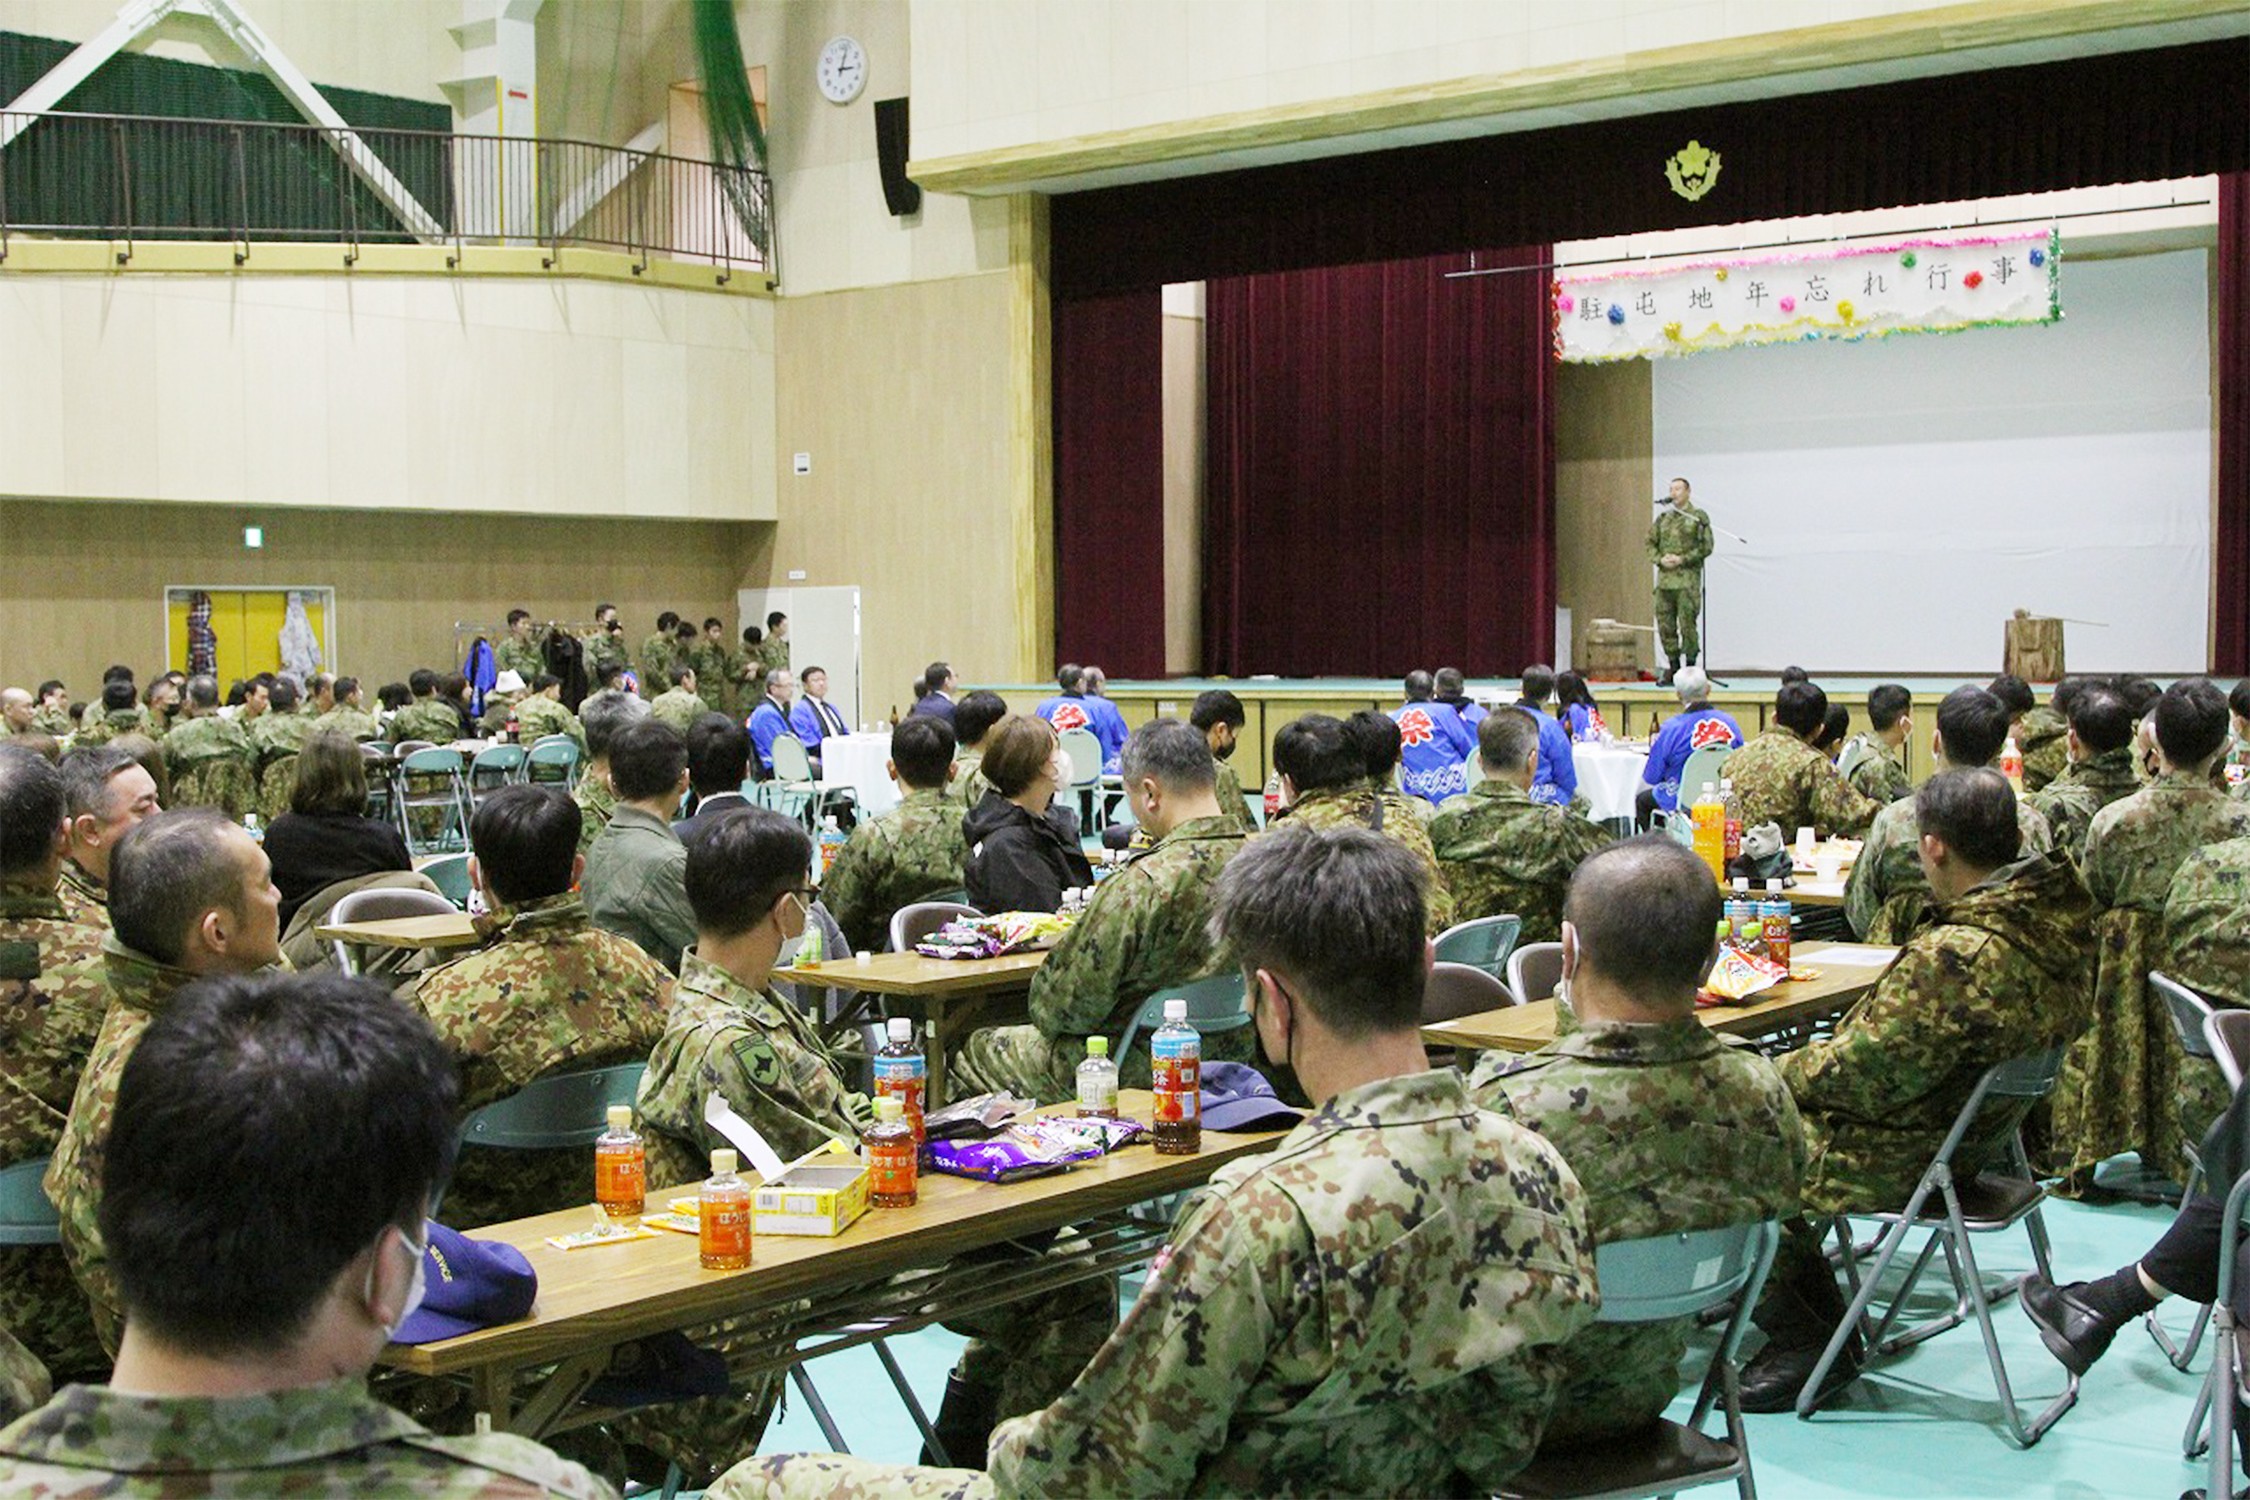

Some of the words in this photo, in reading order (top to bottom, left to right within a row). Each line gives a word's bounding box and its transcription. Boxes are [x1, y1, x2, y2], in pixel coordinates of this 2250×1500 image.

[1580, 255, 2018, 322] 駐屯地年忘れ行事
